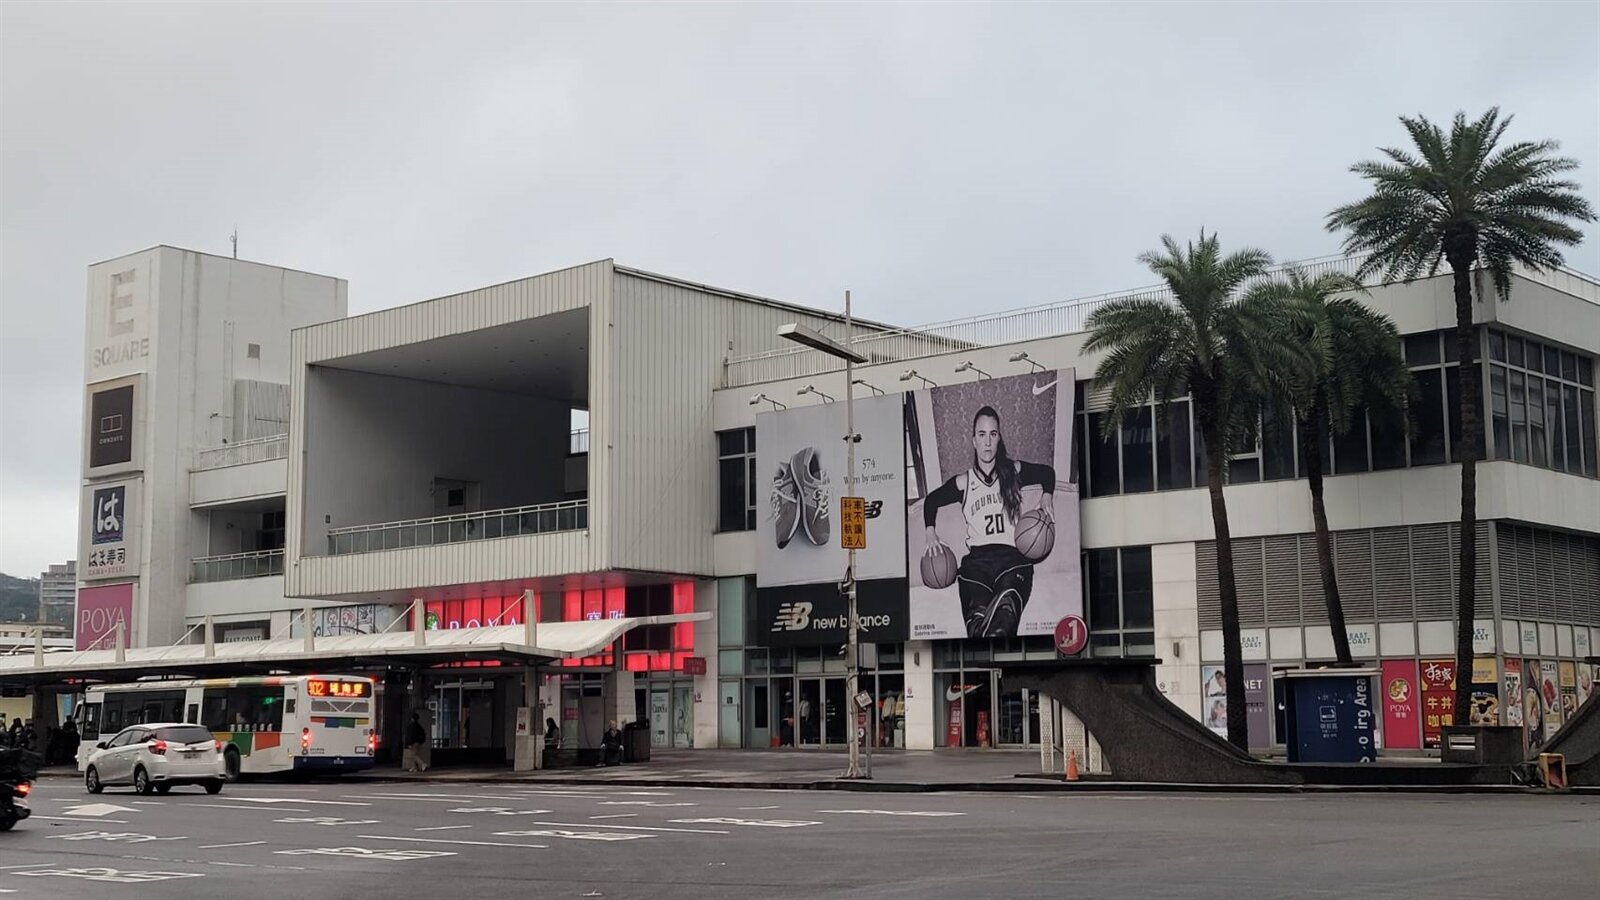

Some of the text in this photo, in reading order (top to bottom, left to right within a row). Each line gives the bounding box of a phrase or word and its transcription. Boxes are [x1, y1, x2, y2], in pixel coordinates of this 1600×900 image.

[109, 269, 136, 338] E
[94, 337, 149, 368] SQUARE
[862, 457, 875, 469] 574
[843, 475, 860, 484] Wrn
[861, 473, 869, 485] by
[96, 493, 120, 533] は
[984, 513, 1005, 535] 20
[88, 548, 125, 568] はま寿司
[813, 613, 891, 630] new blance
[1390, 704, 1411, 712] POYA
